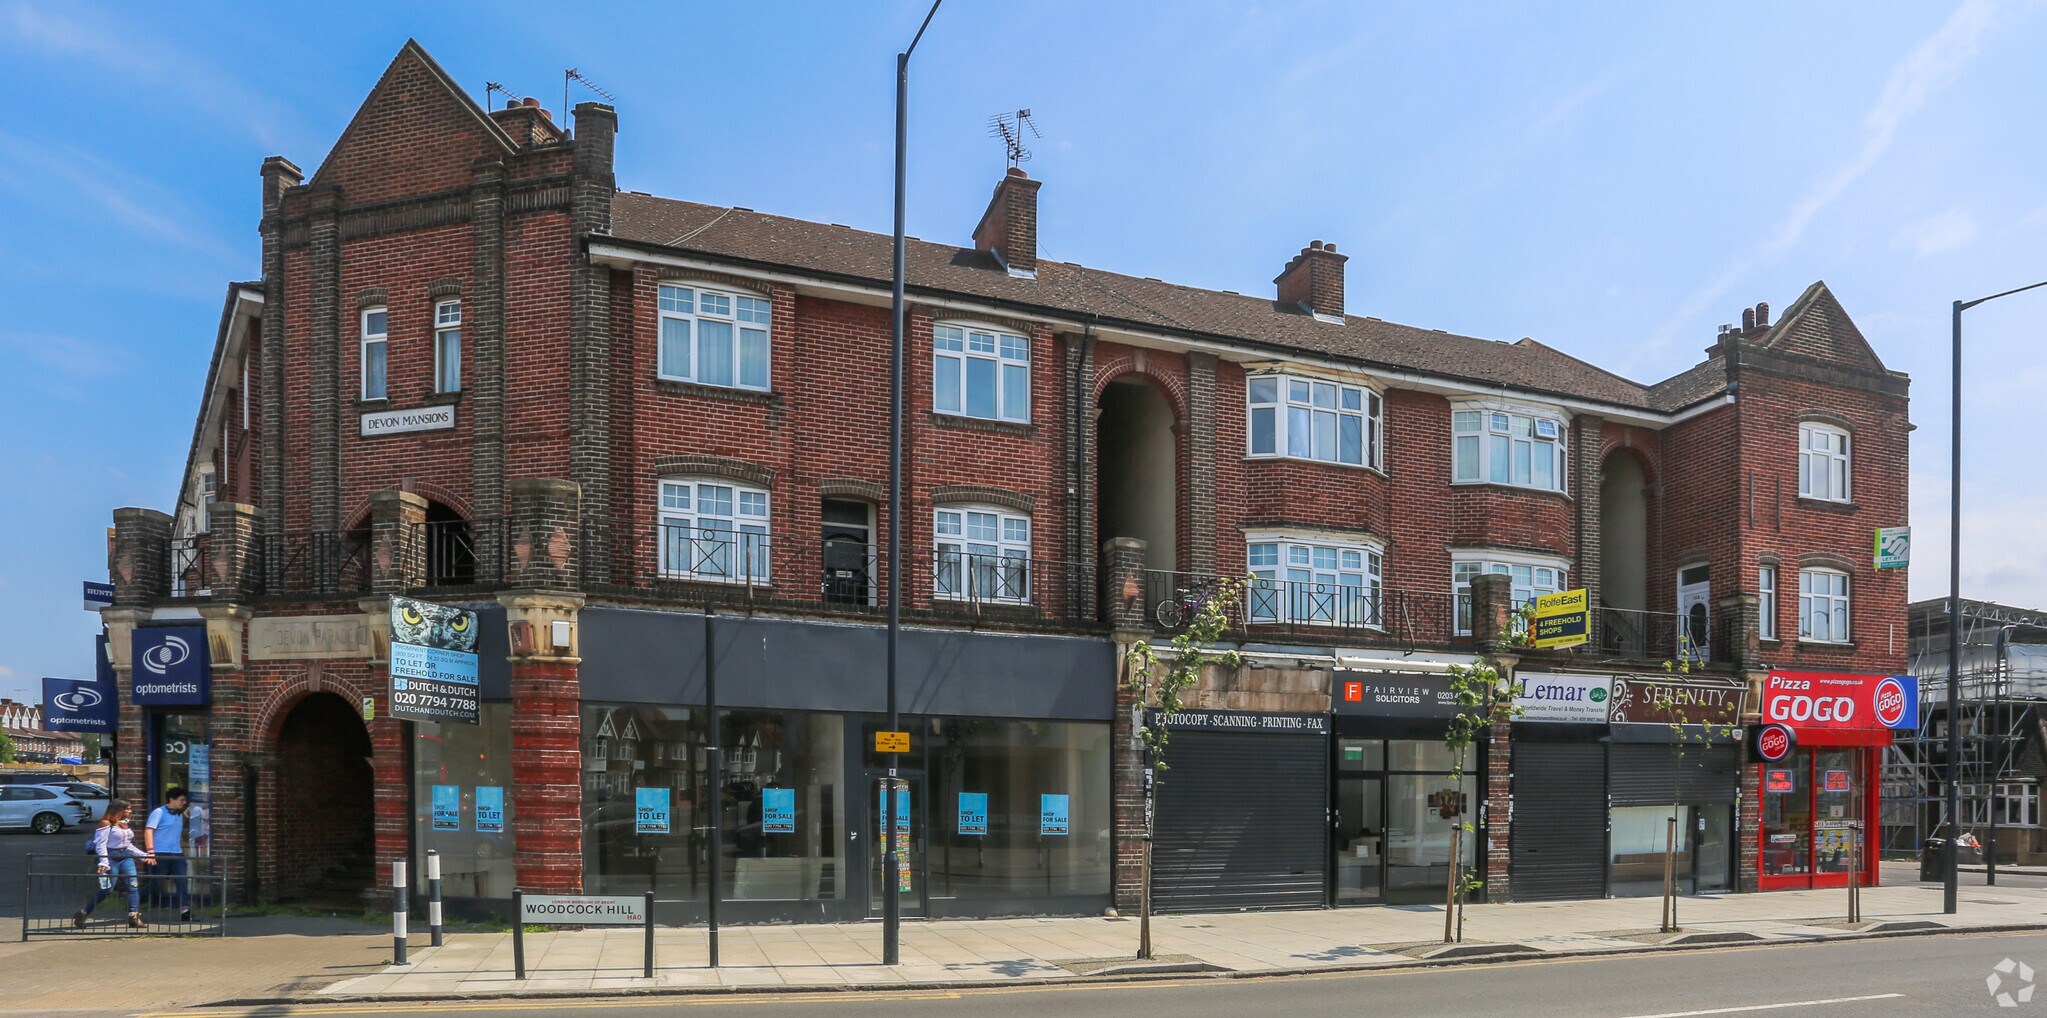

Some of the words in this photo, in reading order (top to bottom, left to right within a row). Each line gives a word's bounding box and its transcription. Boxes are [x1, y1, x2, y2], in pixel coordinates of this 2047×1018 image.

[368, 417, 400, 429] DEVON
[403, 412, 449, 426] MANSIONS
[1540, 594, 1582, 608] RolfeEast
[1544, 616, 1582, 626] FREEHOLD
[277, 630, 310, 646] DEVON
[314, 628, 354, 644] PARADE
[1540, 626, 1562, 636] SHOPS
[395, 644, 426, 653] PROMINENT
[395, 667, 437, 678] FREEHOLD
[136, 682, 197, 695] optometrists
[408, 682, 438, 692] DUTCH
[440, 685, 447, 694] &
[448, 686, 475, 696] DUTCH
[1519, 678, 1586, 701] Lemar
[1770, 677, 1810, 690] Pizza
[1349, 684, 1358, 698] F
[1365, 686, 1429, 695] FAIRVIEW
[1643, 687, 1727, 706] SERENITY
[394, 692, 416, 704] 020
[419, 695, 447, 707] 7794
[450, 698, 476, 710] 7788
[1375, 694, 1420, 703] SOLICITORS
[1879, 693, 1901, 711] GOGO
[395, 705, 475, 718] DUTCHANDDUTCH.COM
[1770, 695, 1855, 722] GOGO
[50, 717, 106, 726] optometrists
[1213, 716, 1256, 727] SCANNING
[1262, 716, 1301, 728] PRINTING
[1307, 718, 1323, 728] FAX
[1762, 735, 1785, 750] GOGO
[526, 904, 602, 914] WOODCOCK
[607, 905, 633, 914] HILL
